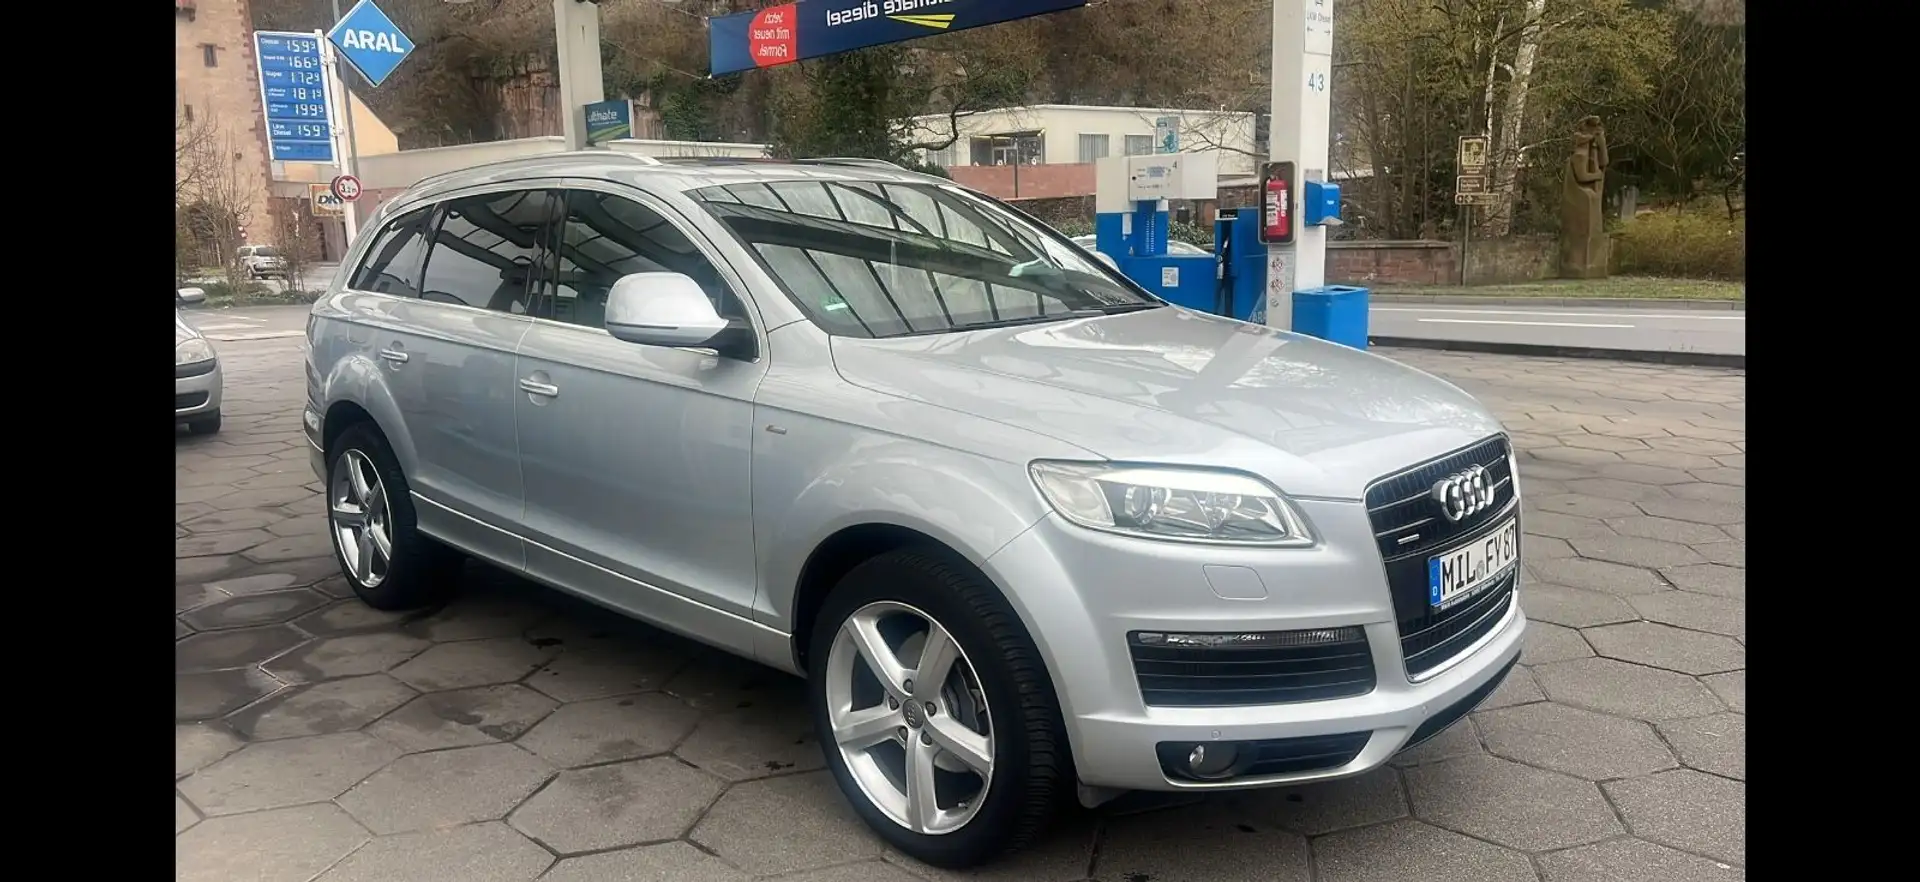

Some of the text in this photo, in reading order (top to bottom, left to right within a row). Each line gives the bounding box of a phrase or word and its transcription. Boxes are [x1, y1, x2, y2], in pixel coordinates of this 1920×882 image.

[343, 29, 404, 53] ARAL
[1442, 551, 1476, 596] MIL
[1485, 533, 1502, 574] FY
[1504, 524, 1514, 560] 87
[1432, 586, 1438, 596] D
